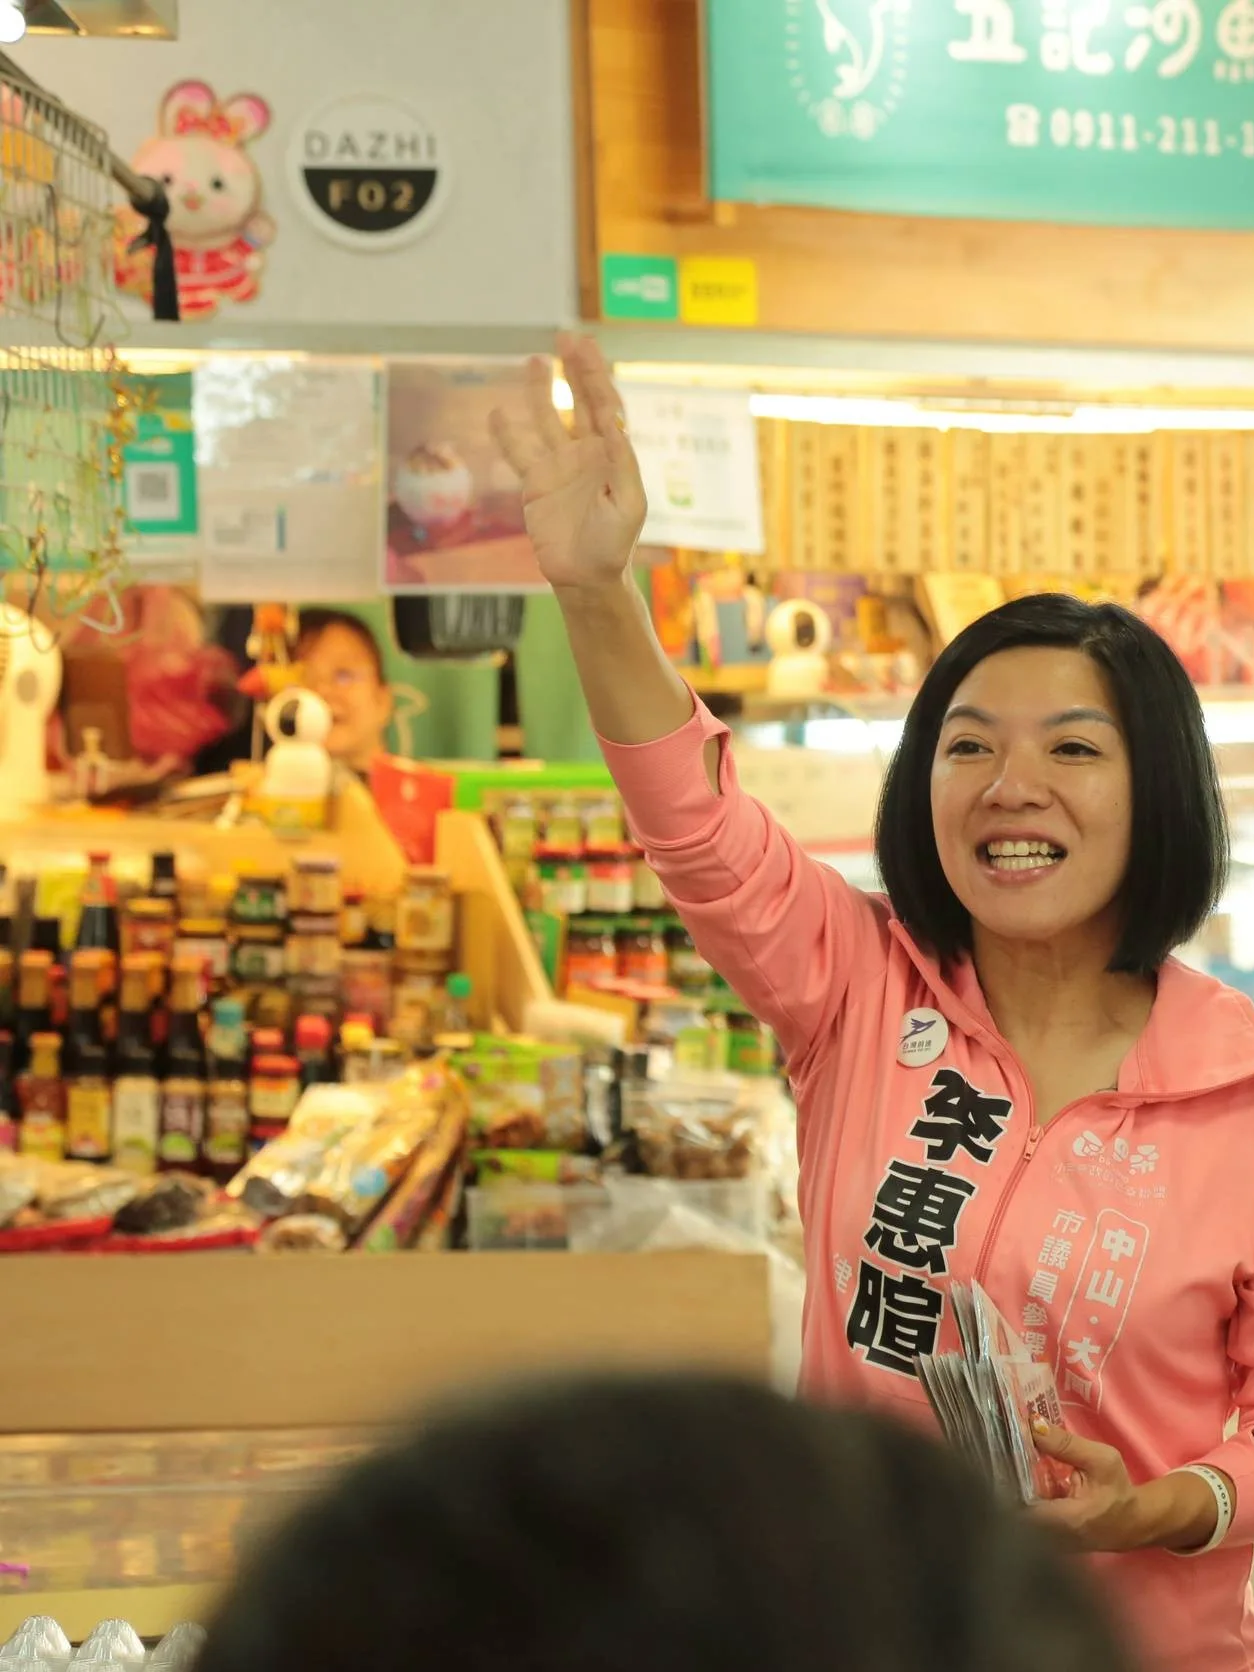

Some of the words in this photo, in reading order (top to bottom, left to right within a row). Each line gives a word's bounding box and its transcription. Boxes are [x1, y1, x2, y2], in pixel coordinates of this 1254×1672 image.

[303, 130, 437, 161] DAZHI
[328, 179, 415, 213] F02
[846, 1068, 1013, 1380] 李惠暄
